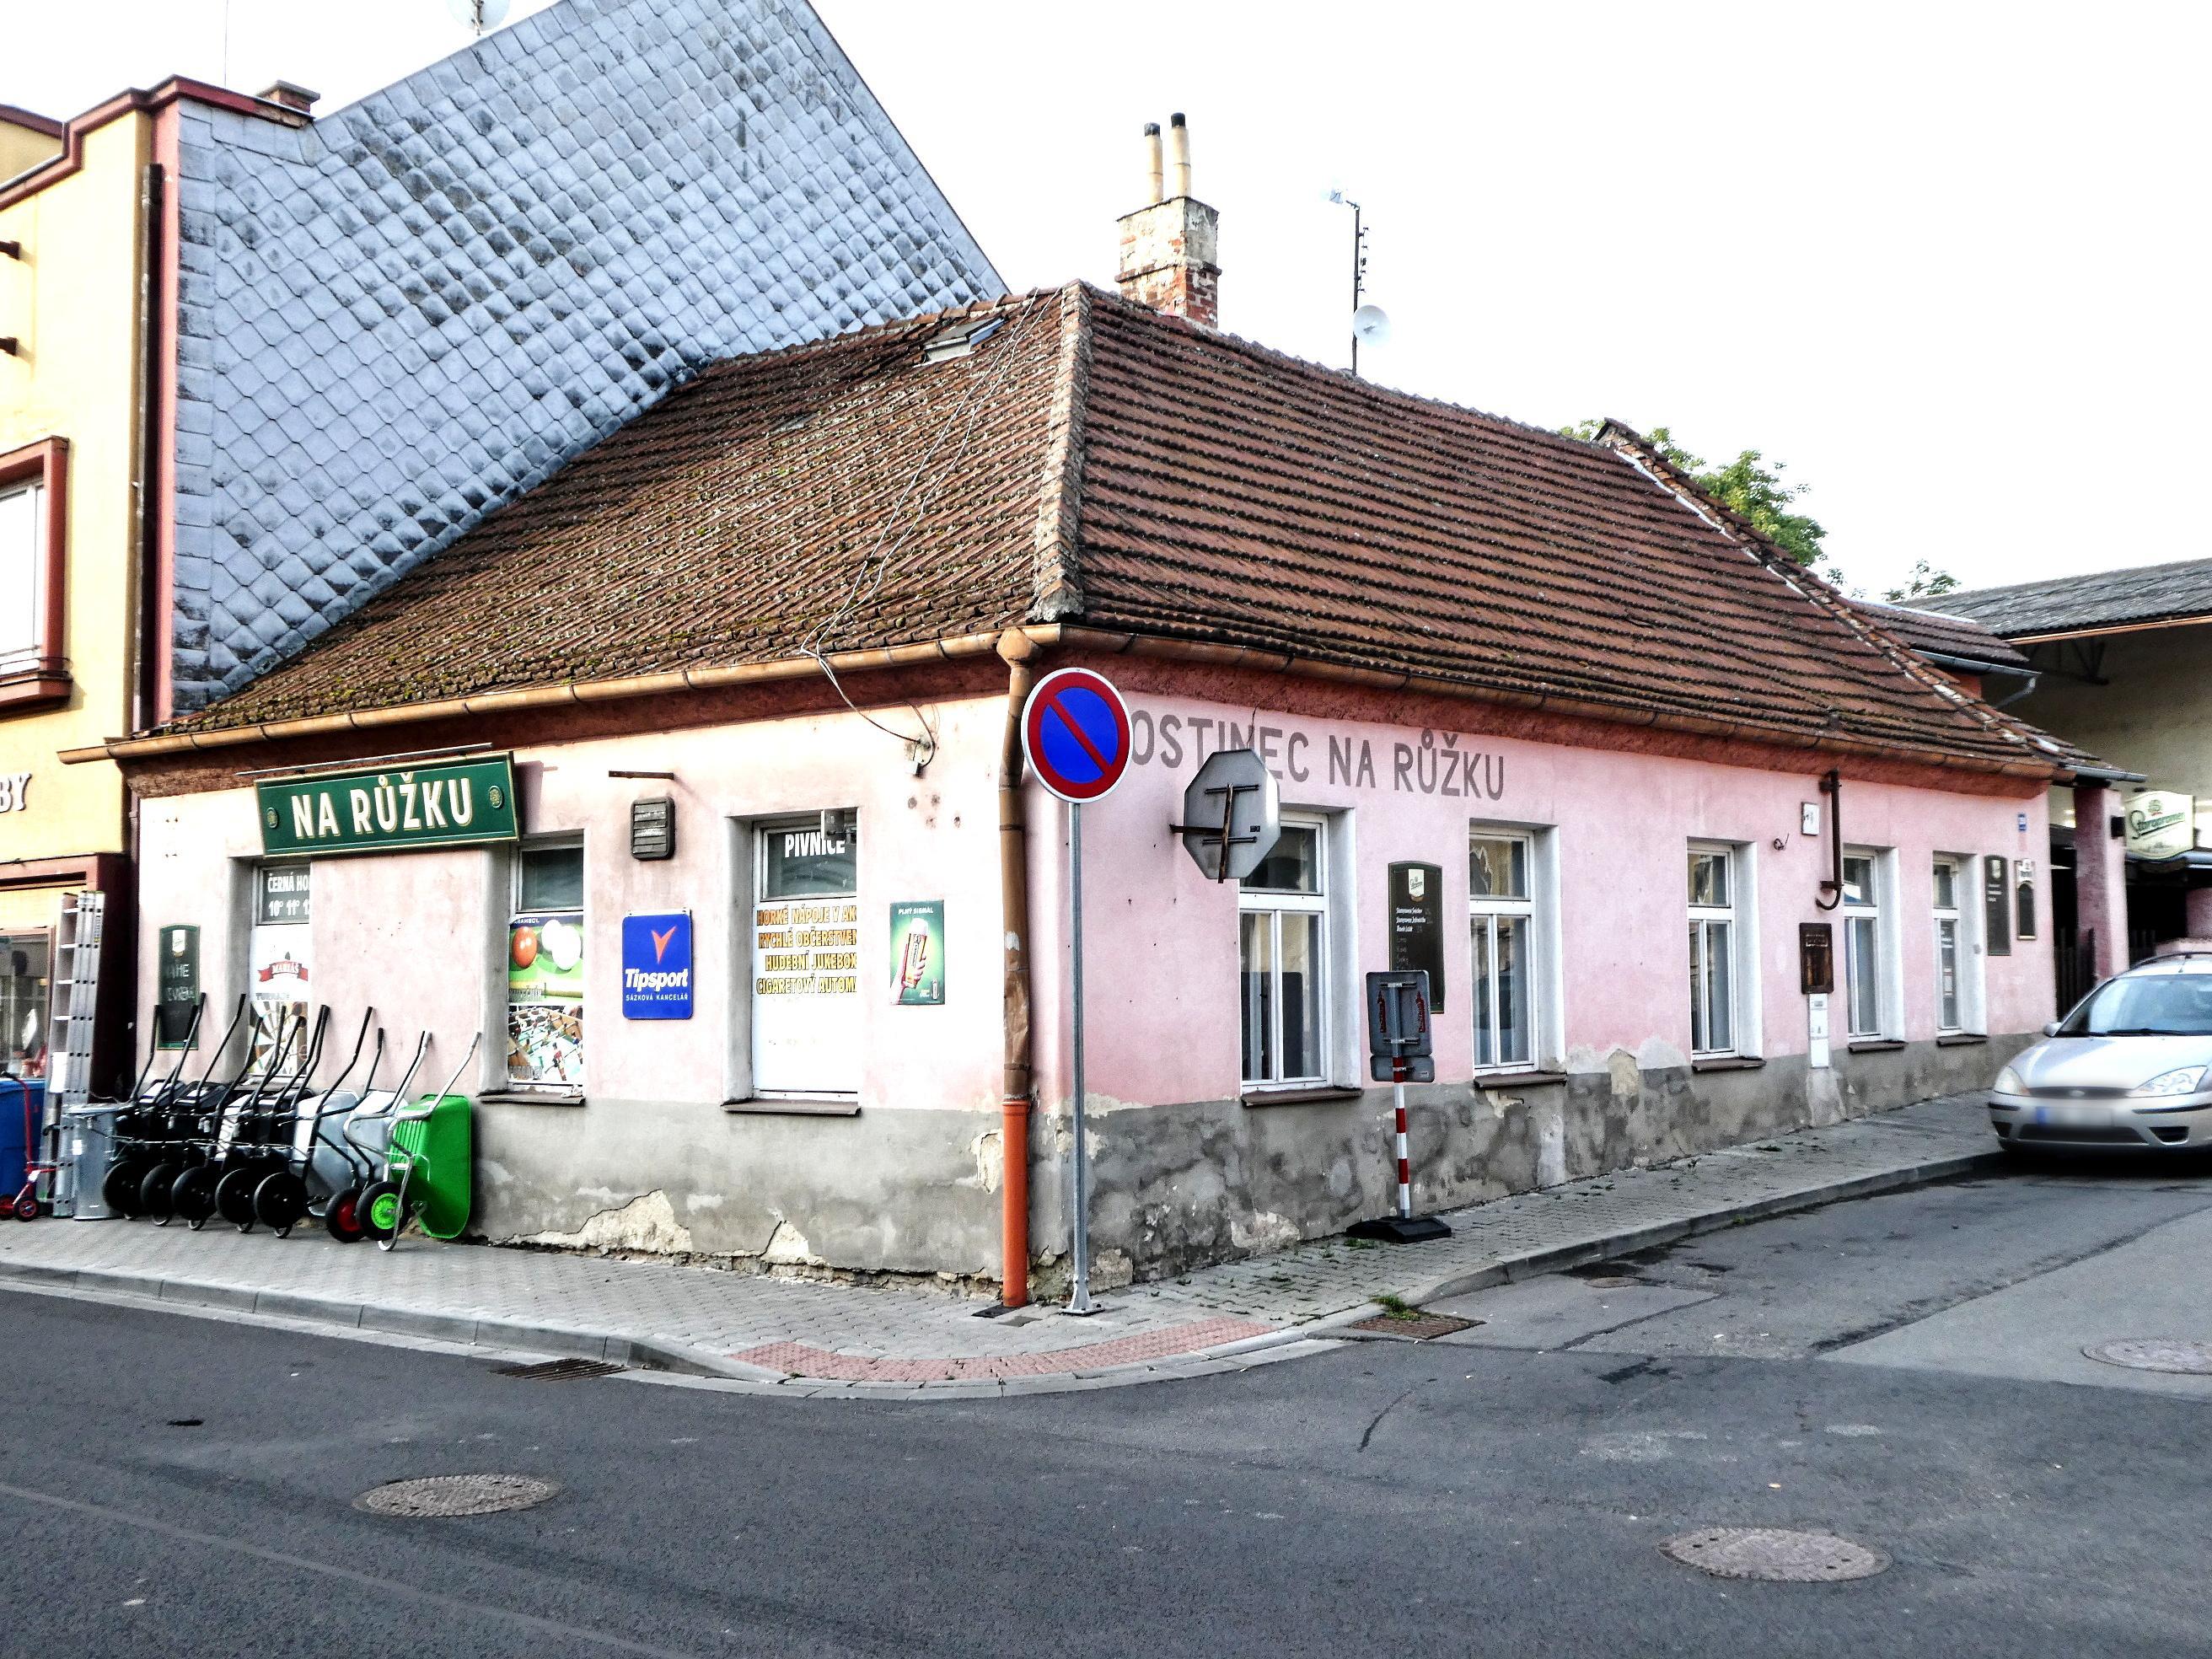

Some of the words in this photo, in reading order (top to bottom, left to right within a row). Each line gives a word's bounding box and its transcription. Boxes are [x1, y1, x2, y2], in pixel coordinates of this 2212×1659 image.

[1131, 711, 1310, 782] OSTINEC
[1329, 735, 1377, 789] NA
[1393, 727, 1505, 801] RŮŽKU
[292, 792, 341, 839] NA
[350, 771, 473, 835] RŮŽKU
[785, 831, 846, 858] PIVNICE
[268, 872, 295, 893] ČERNÁ
[296, 874, 310, 890] HO
[303, 899, 310, 915] 1
[757, 905, 789, 926] HORKÉ
[792, 904, 830, 924] NÁPOJE
[832, 906, 840, 923] V
[758, 927, 793, 948] RYCHLÉ
[765, 950, 809, 971] HUDEBNÍ
[811, 953, 856, 970] JUKEBOX
[625, 968, 689, 992] Tipsport
[755, 973, 815, 995] CIGARETOVÝ
[625, 992, 653, 1001] SÁZKOVÁ
